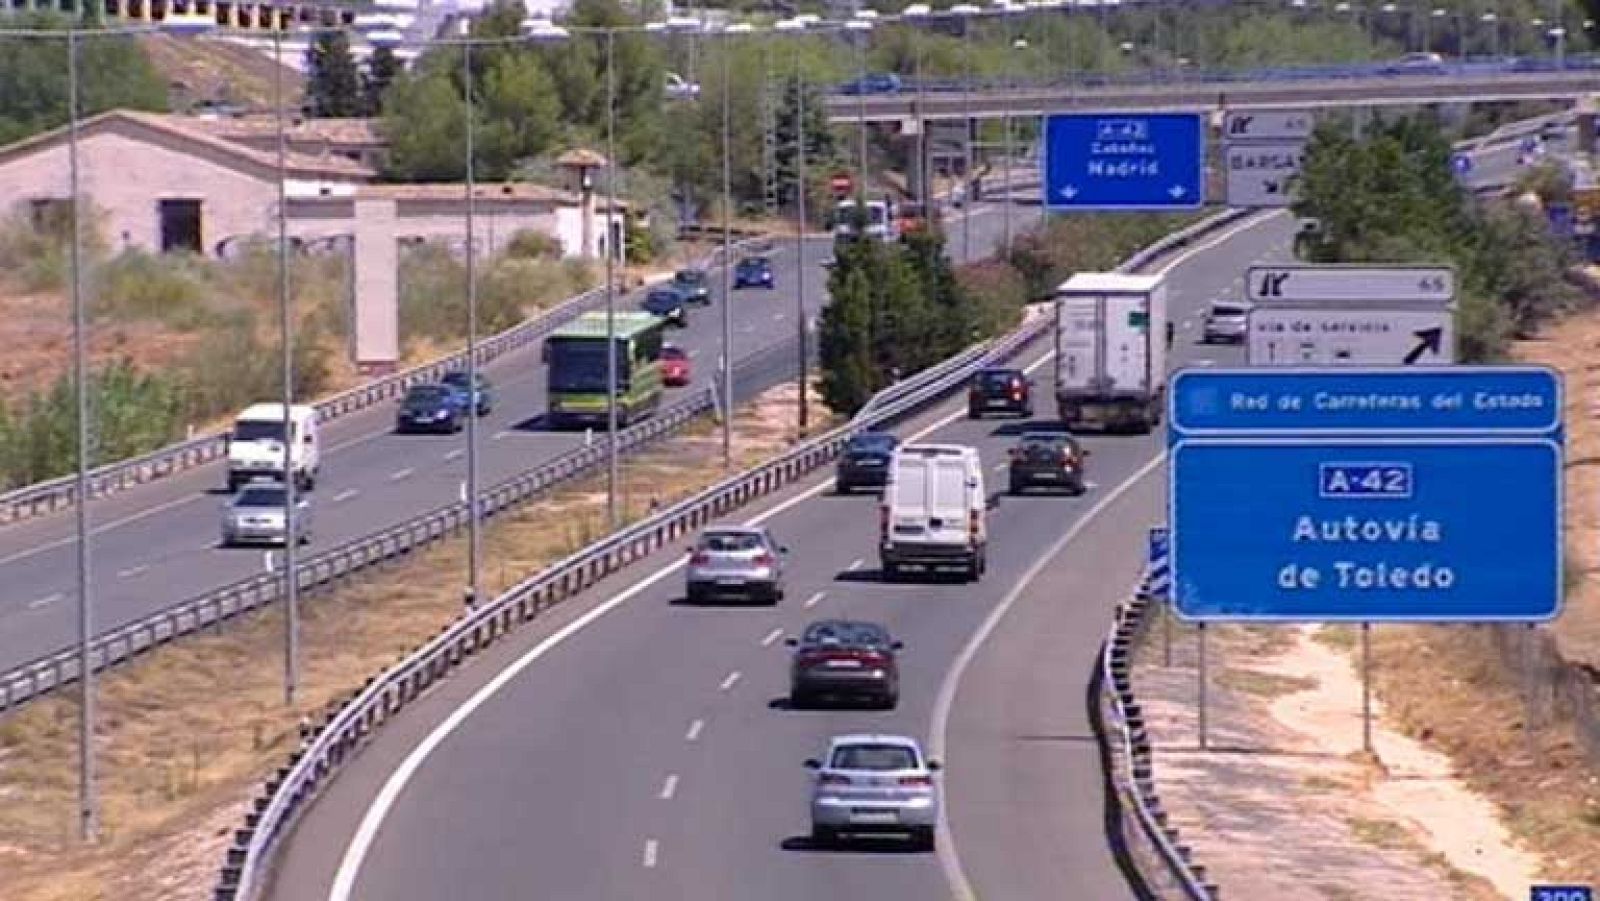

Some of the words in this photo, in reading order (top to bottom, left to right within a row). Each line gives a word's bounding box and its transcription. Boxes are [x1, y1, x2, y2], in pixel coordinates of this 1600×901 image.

[1087, 160, 1159, 176] Madrid
[1231, 391, 1268, 411] Red
[1278, 392, 1301, 411] de
[1314, 390, 1422, 411] Carreteras
[1431, 390, 1462, 410] del
[1473, 390, 1544, 410] Estado
[1293, 514, 1441, 542] Autovía
[1277, 562, 1320, 590] de
[1333, 561, 1455, 590] Toledo
